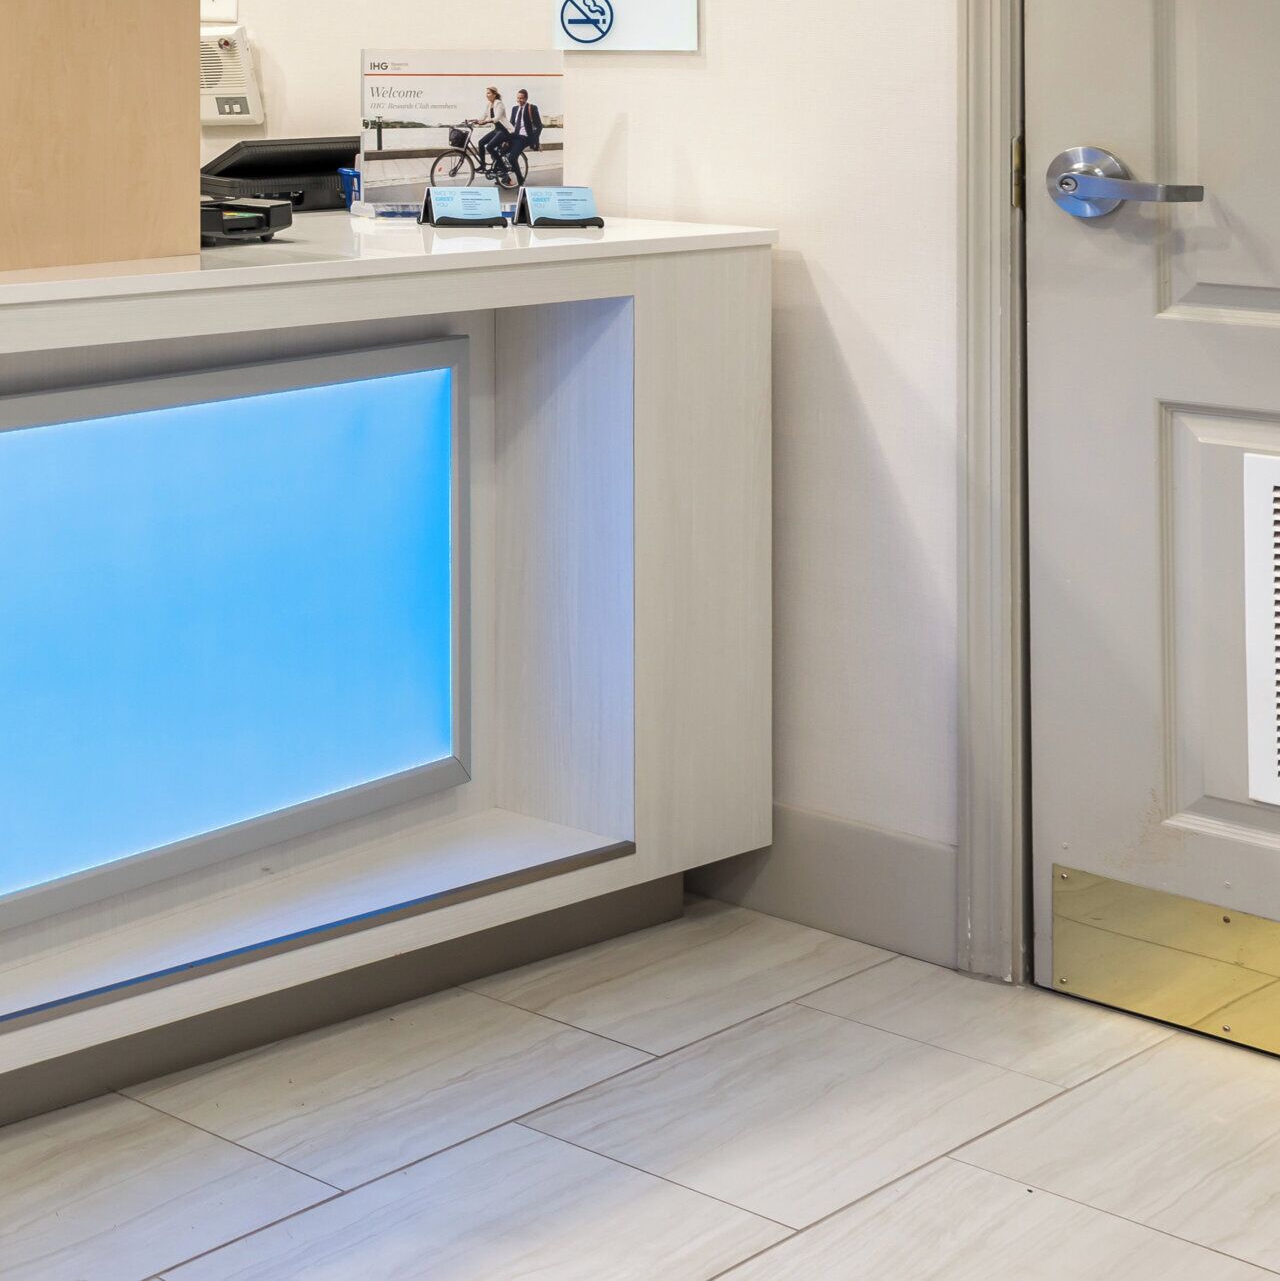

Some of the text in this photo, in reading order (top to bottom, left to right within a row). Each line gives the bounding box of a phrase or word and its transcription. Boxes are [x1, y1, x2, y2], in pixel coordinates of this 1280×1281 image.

[369, 62, 389, 71] IHG
[370, 86, 423, 99] Welcome
[430, 102, 458, 110] members
